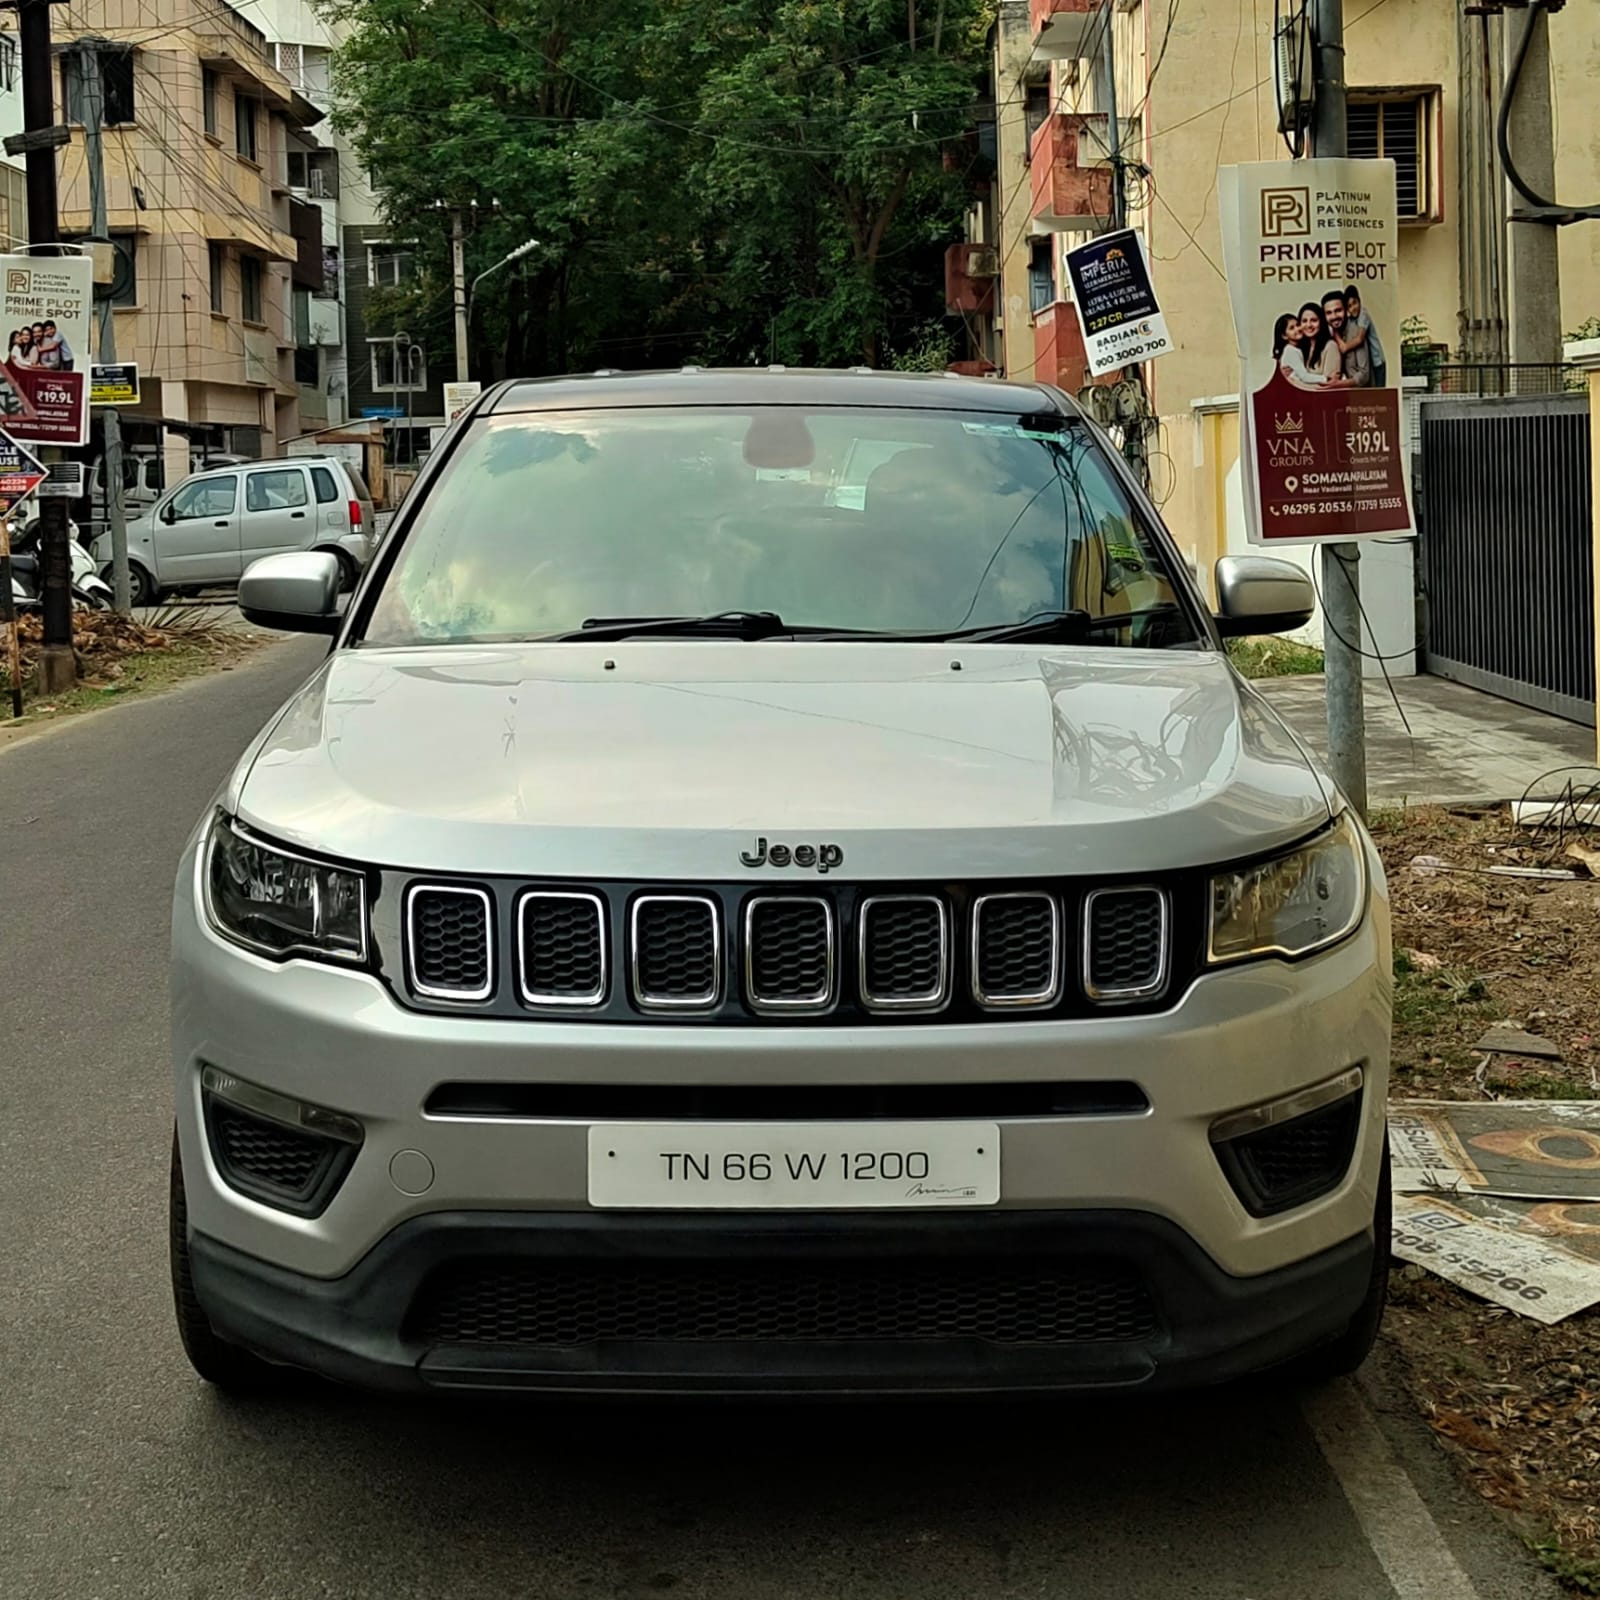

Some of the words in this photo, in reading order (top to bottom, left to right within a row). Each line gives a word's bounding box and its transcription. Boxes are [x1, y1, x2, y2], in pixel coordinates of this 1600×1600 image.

[1316, 191, 1371, 202] PLATINUM
[1316, 205, 1368, 215] PAVILION
[1317, 218, 1385, 229] RESIDENCES
[1260, 242, 1341, 262] PRIME
[1345, 242, 1386, 259] PLOT
[33, 273, 71, 281] PLATINUM
[1080, 258, 1129, 282] IMPERIA
[1260, 263, 1342, 284] PRIME
[1345, 263, 1387, 280] SPOT
[33, 287, 81, 295] RESIDENCES
[5, 296, 44, 307] PRIME
[47, 298, 82, 309] PLOT
[4, 306, 44, 317] PRIME
[46, 309, 81, 320] SPOT
[1095, 355, 1114, 368] 900
[1116, 347, 1144, 362] 3000
[1144, 338, 1167, 351] 700
[1266, 437, 1316, 456] VNA
[1345, 430, 1390, 454] ₹19.9L
[1269, 455, 1314, 467] GROUPS
[1282, 503, 1316, 516] 96295
[1379, 497, 1402, 509] 55555
[739, 837, 843, 873] Jeep
[659, 1152, 709, 1181] TN
[722, 1152, 772, 1181] 66
[784, 1152, 827, 1181] W
[841, 1151, 930, 1180] 1200
